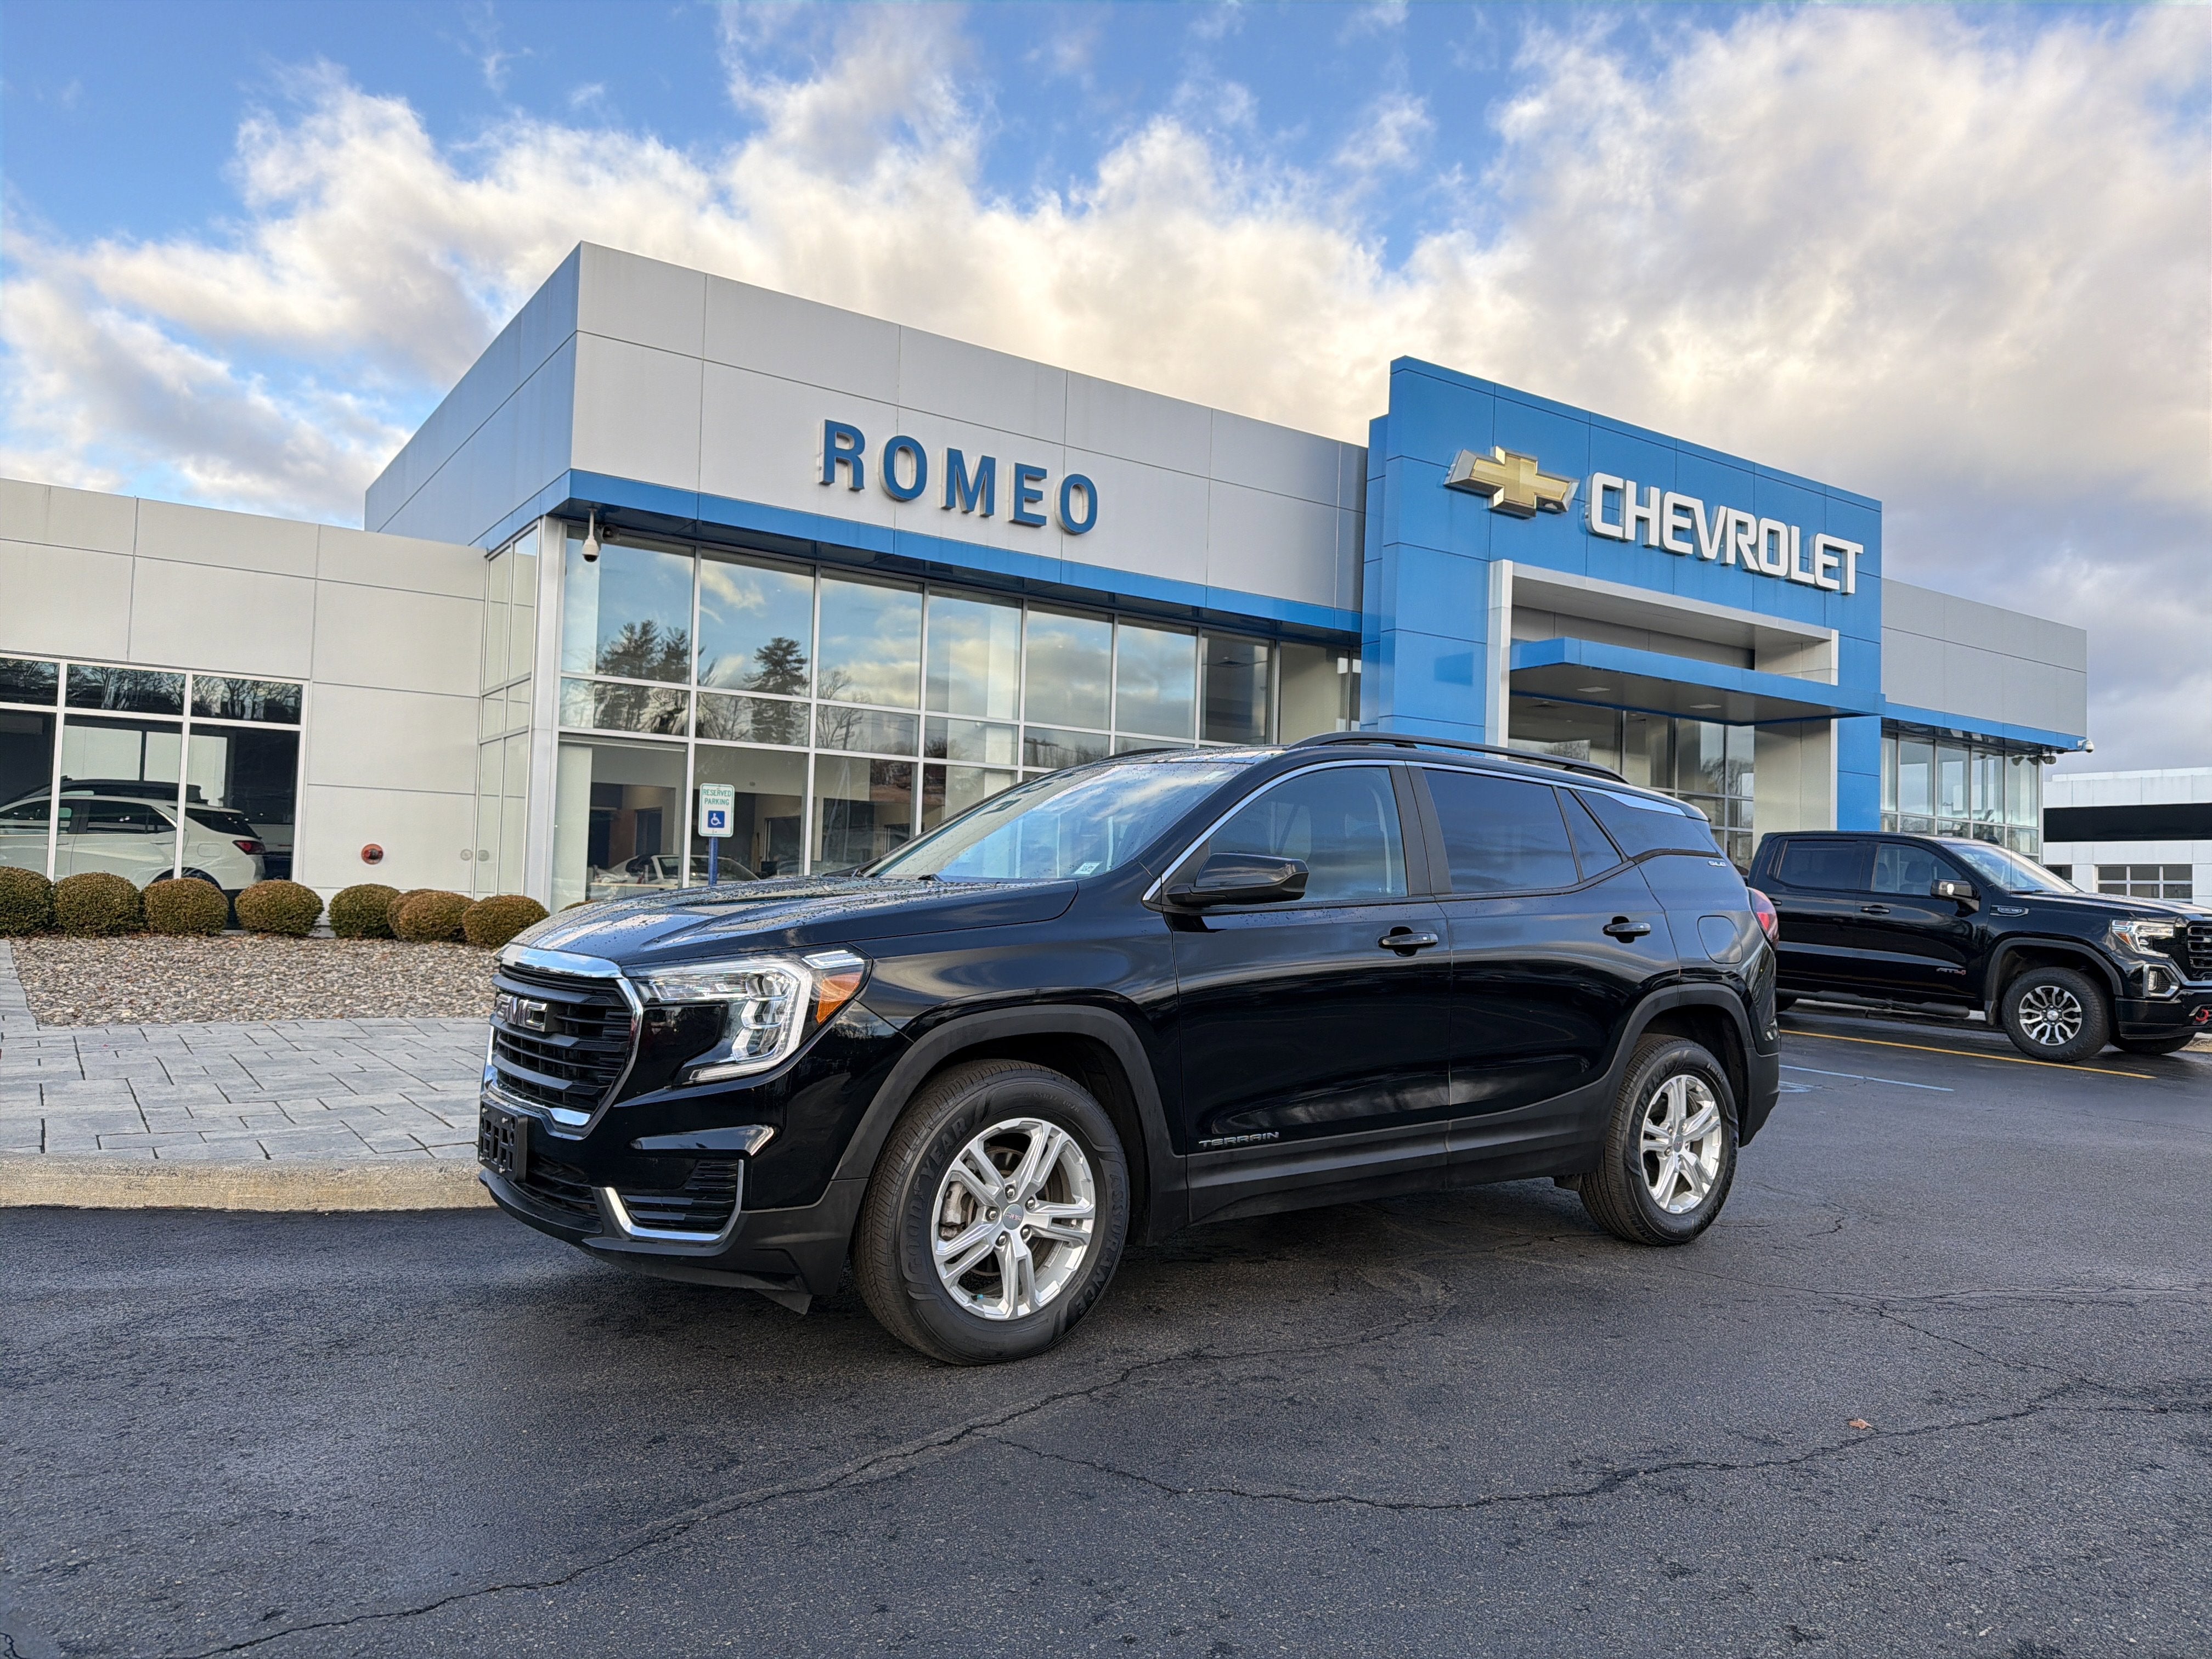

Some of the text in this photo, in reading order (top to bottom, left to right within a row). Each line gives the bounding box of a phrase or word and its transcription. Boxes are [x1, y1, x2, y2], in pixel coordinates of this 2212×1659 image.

[819, 419, 1098, 535] ROMEO
[1585, 472, 1864, 595] CHEVROLET
[702, 789, 732, 797] RESERVED
[495, 994, 548, 1032] GMC
[1198, 1131, 1279, 1148] TERRAIN
[1075, 1173, 1124, 1316] ASSURANCE
